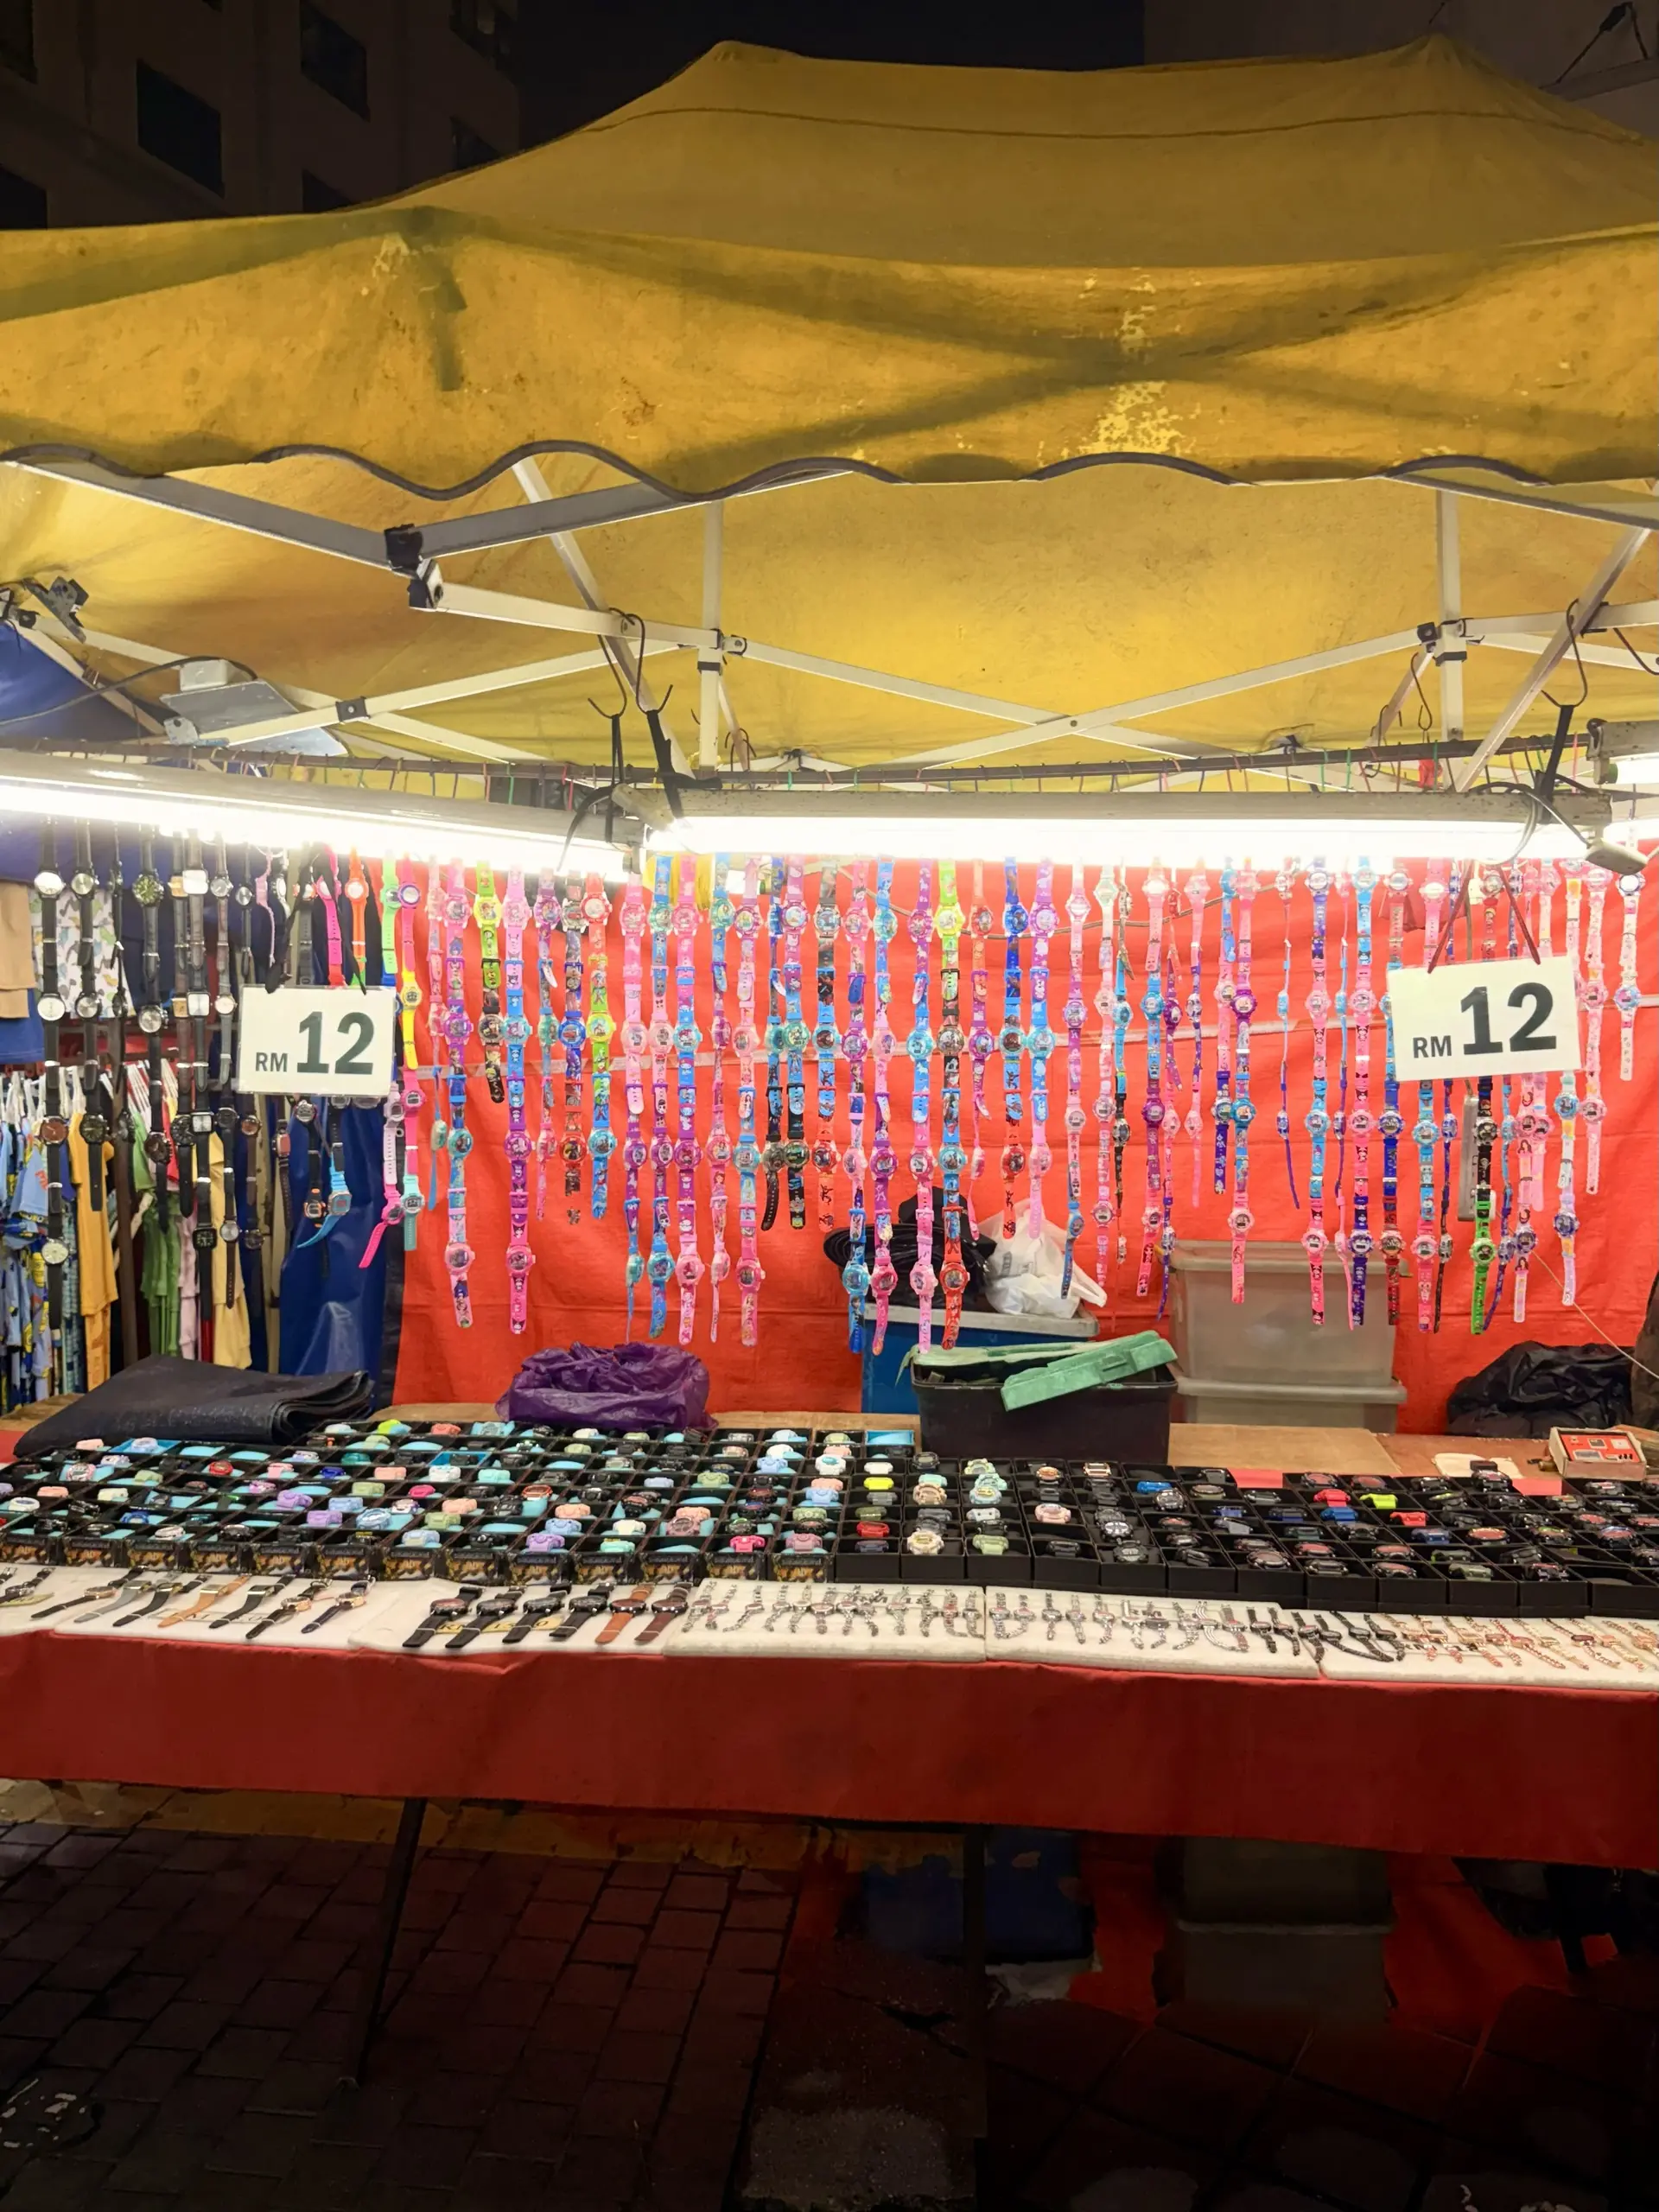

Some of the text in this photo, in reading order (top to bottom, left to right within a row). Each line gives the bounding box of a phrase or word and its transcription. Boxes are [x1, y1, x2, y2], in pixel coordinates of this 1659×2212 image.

[255, 1011, 374, 1075] RM 12
[1413, 982, 1557, 1058] RM 12
